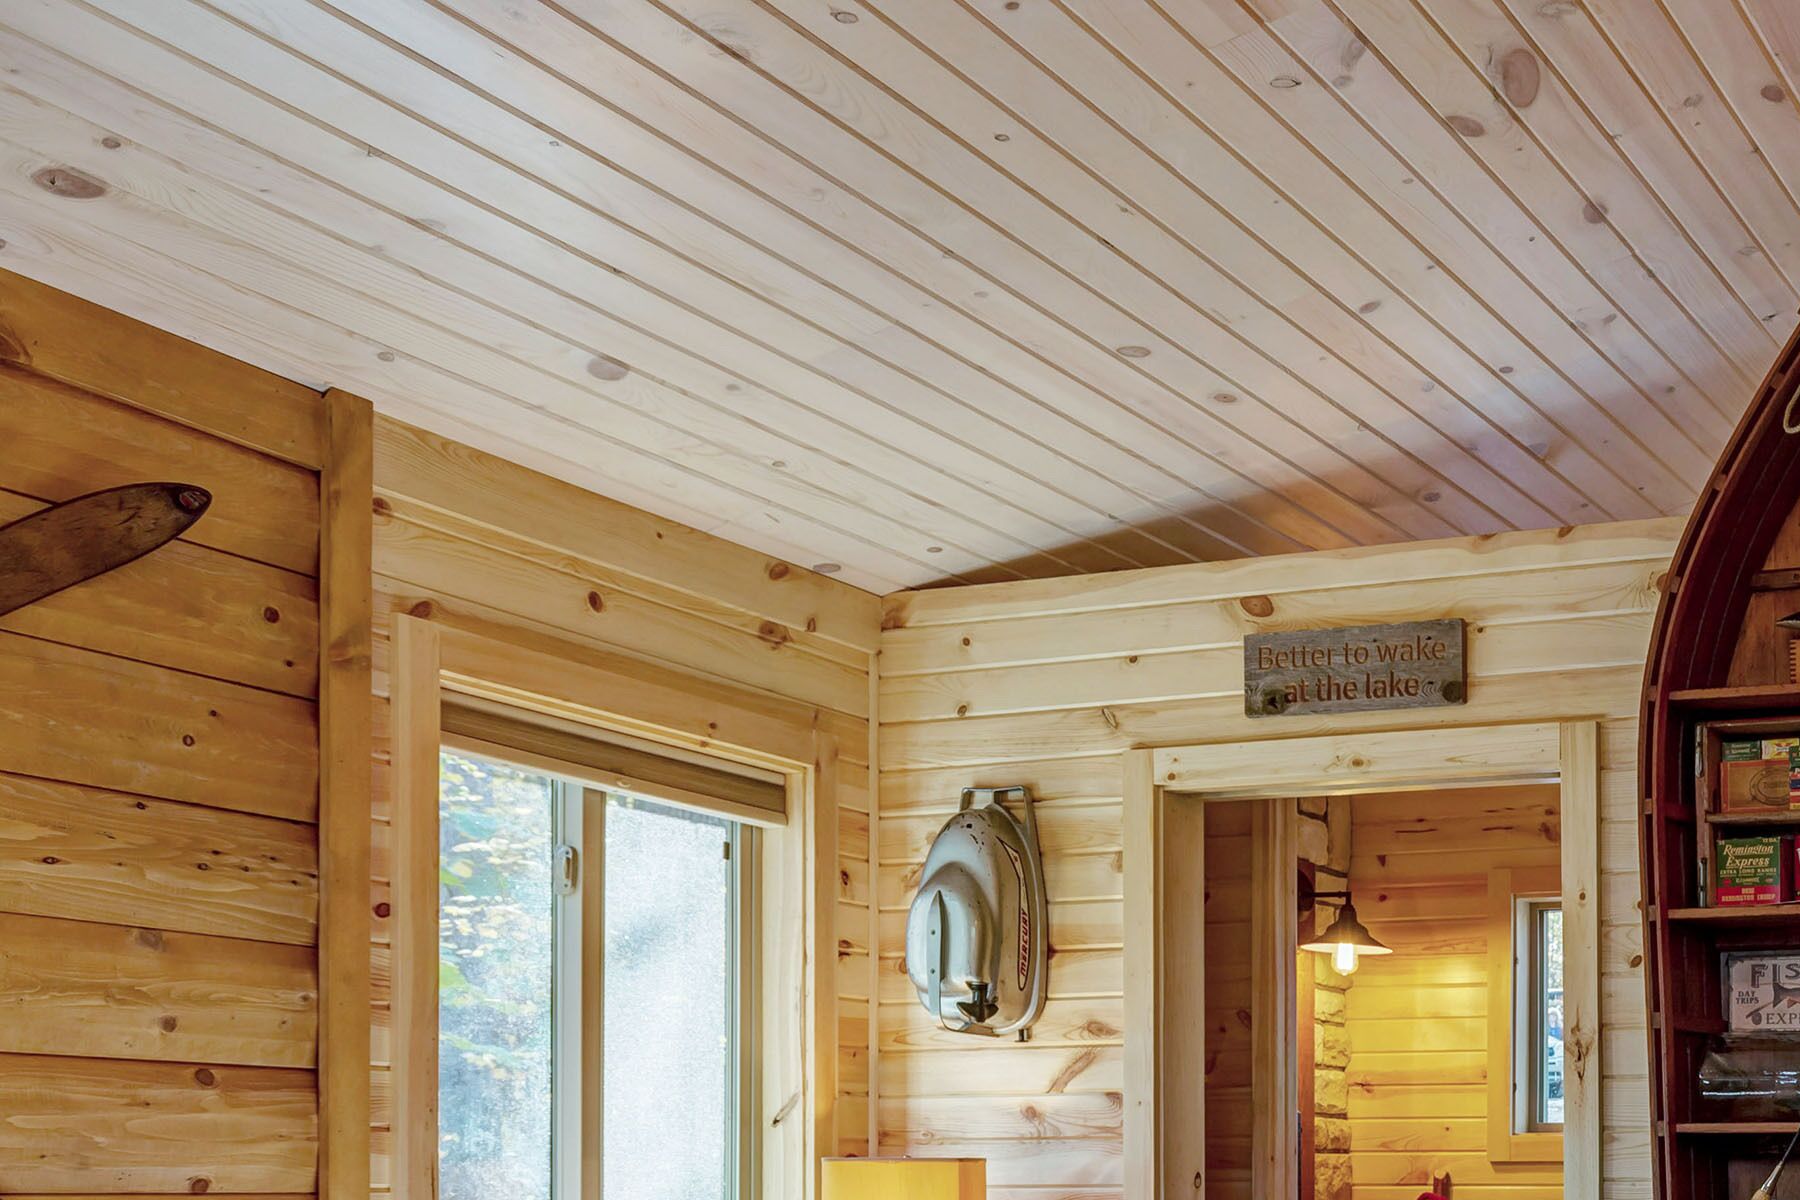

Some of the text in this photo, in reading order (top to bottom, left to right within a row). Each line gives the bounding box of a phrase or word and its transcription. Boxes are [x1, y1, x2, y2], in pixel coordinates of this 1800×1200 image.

[1257, 634, 1447, 671] Better to wake
[1283, 670, 1421, 705] at the lake
[1723, 844, 1774, 857] Remington
[1726, 857, 1770, 869] Express
[1019, 908, 1029, 977] MERCURY
[1737, 990, 1756, 998] DAY
[1735, 997, 1760, 1005] TRIPS
